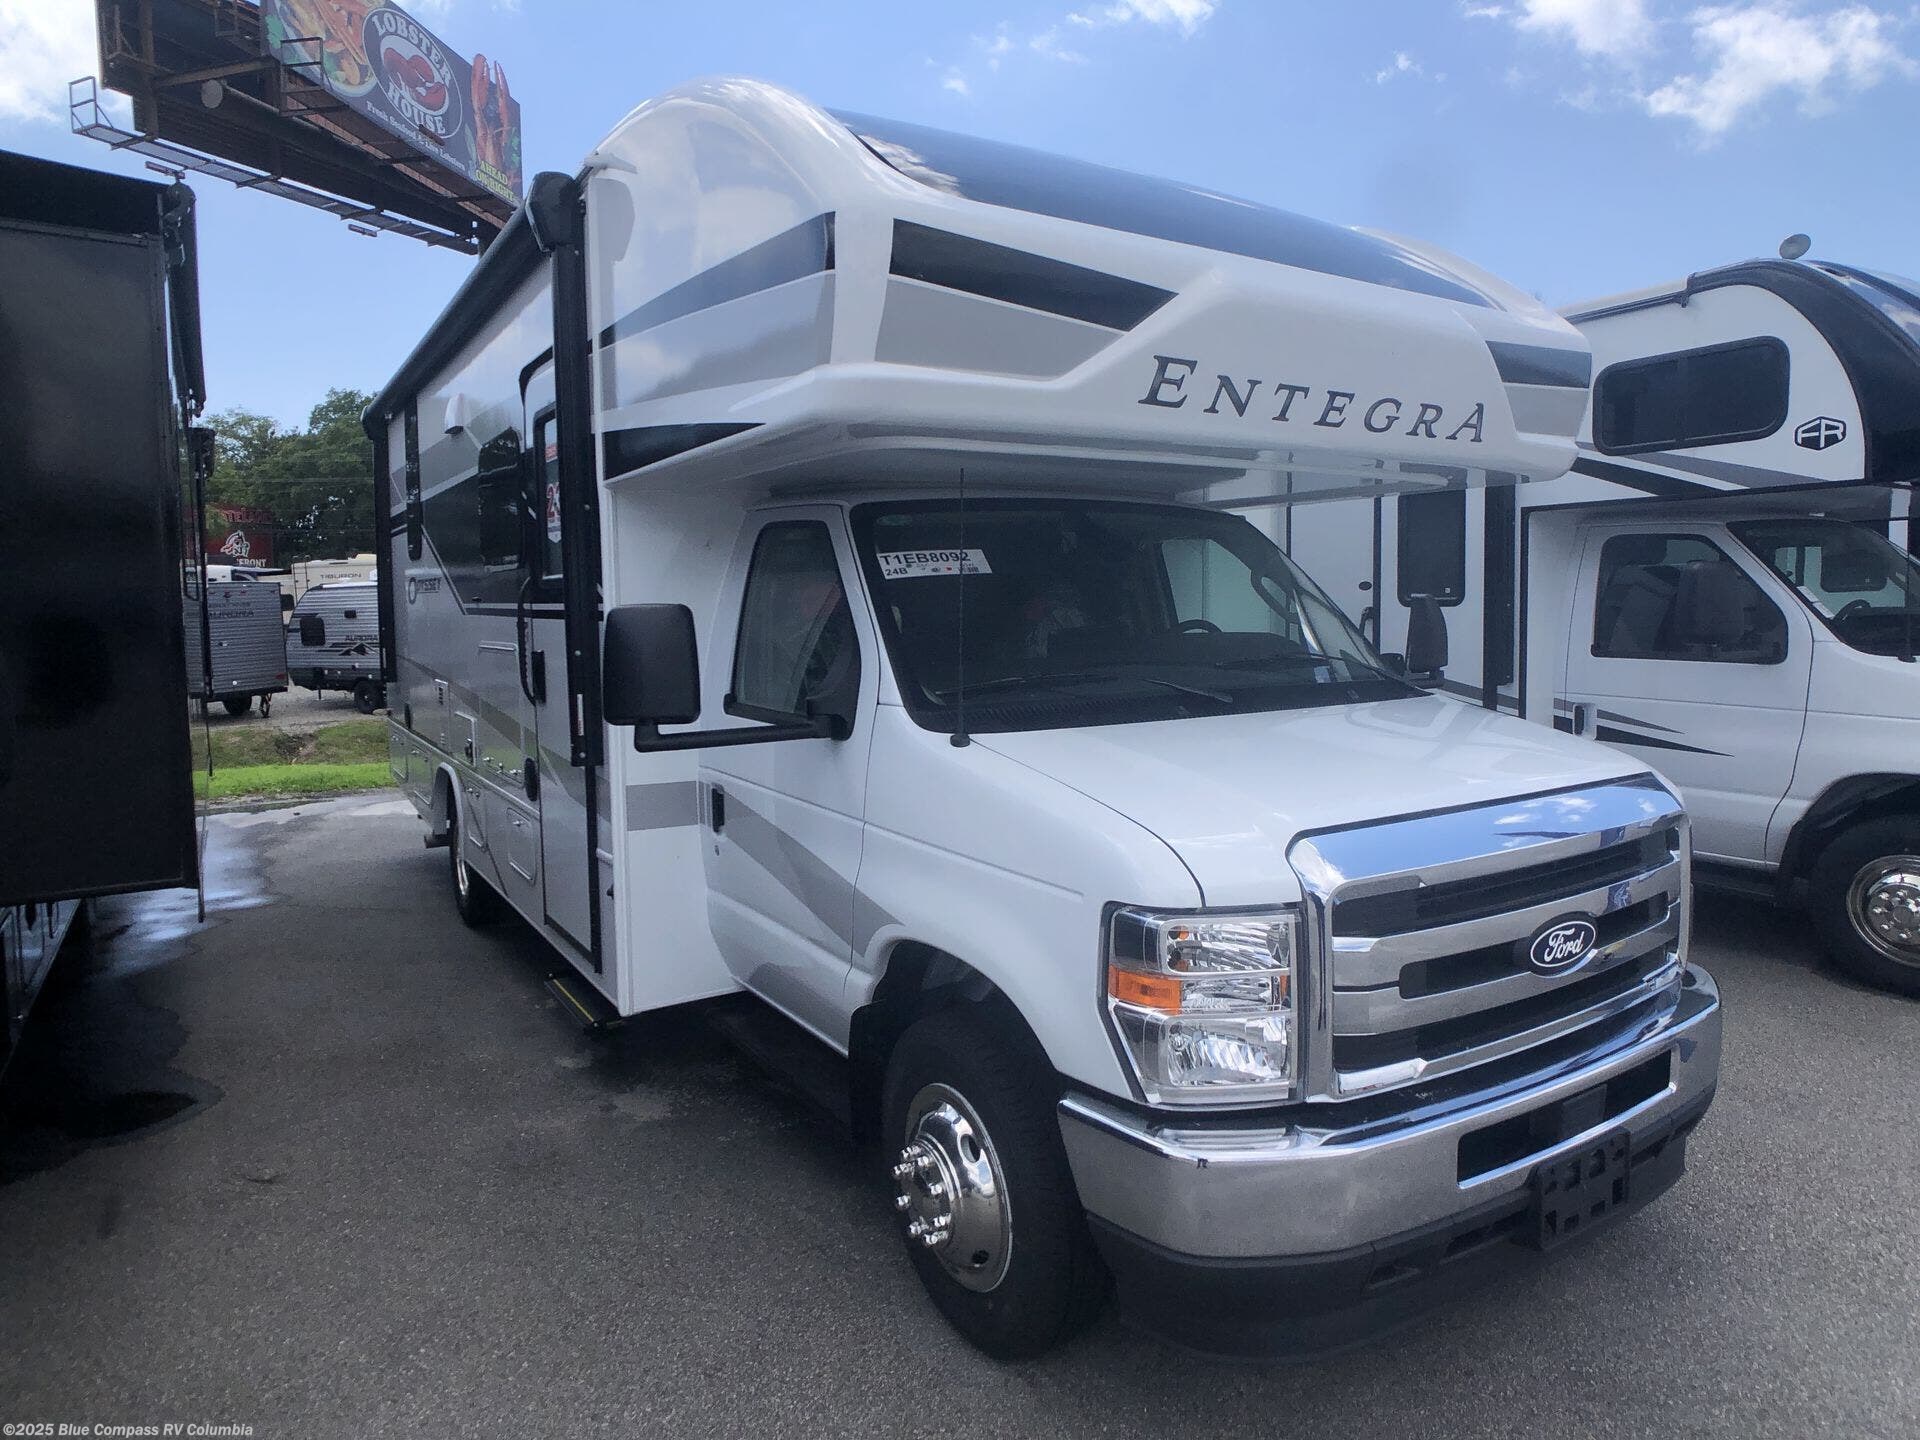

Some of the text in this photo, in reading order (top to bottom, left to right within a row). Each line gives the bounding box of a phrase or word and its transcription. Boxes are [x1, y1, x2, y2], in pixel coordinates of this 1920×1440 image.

[372, 12, 452, 88] LOBSTER
[387, 82, 446, 134] HOUSE
[480, 160, 508, 185] AHEAD
[1138, 354, 1484, 443] ENTEGRA
[880, 551, 971, 566] T1EB8092
[885, 567, 908, 577] 24B
[408, 576, 442, 605] ODYSSEY
[344, 634, 379, 642] AURORA
[1543, 927, 1585, 963] Ford
